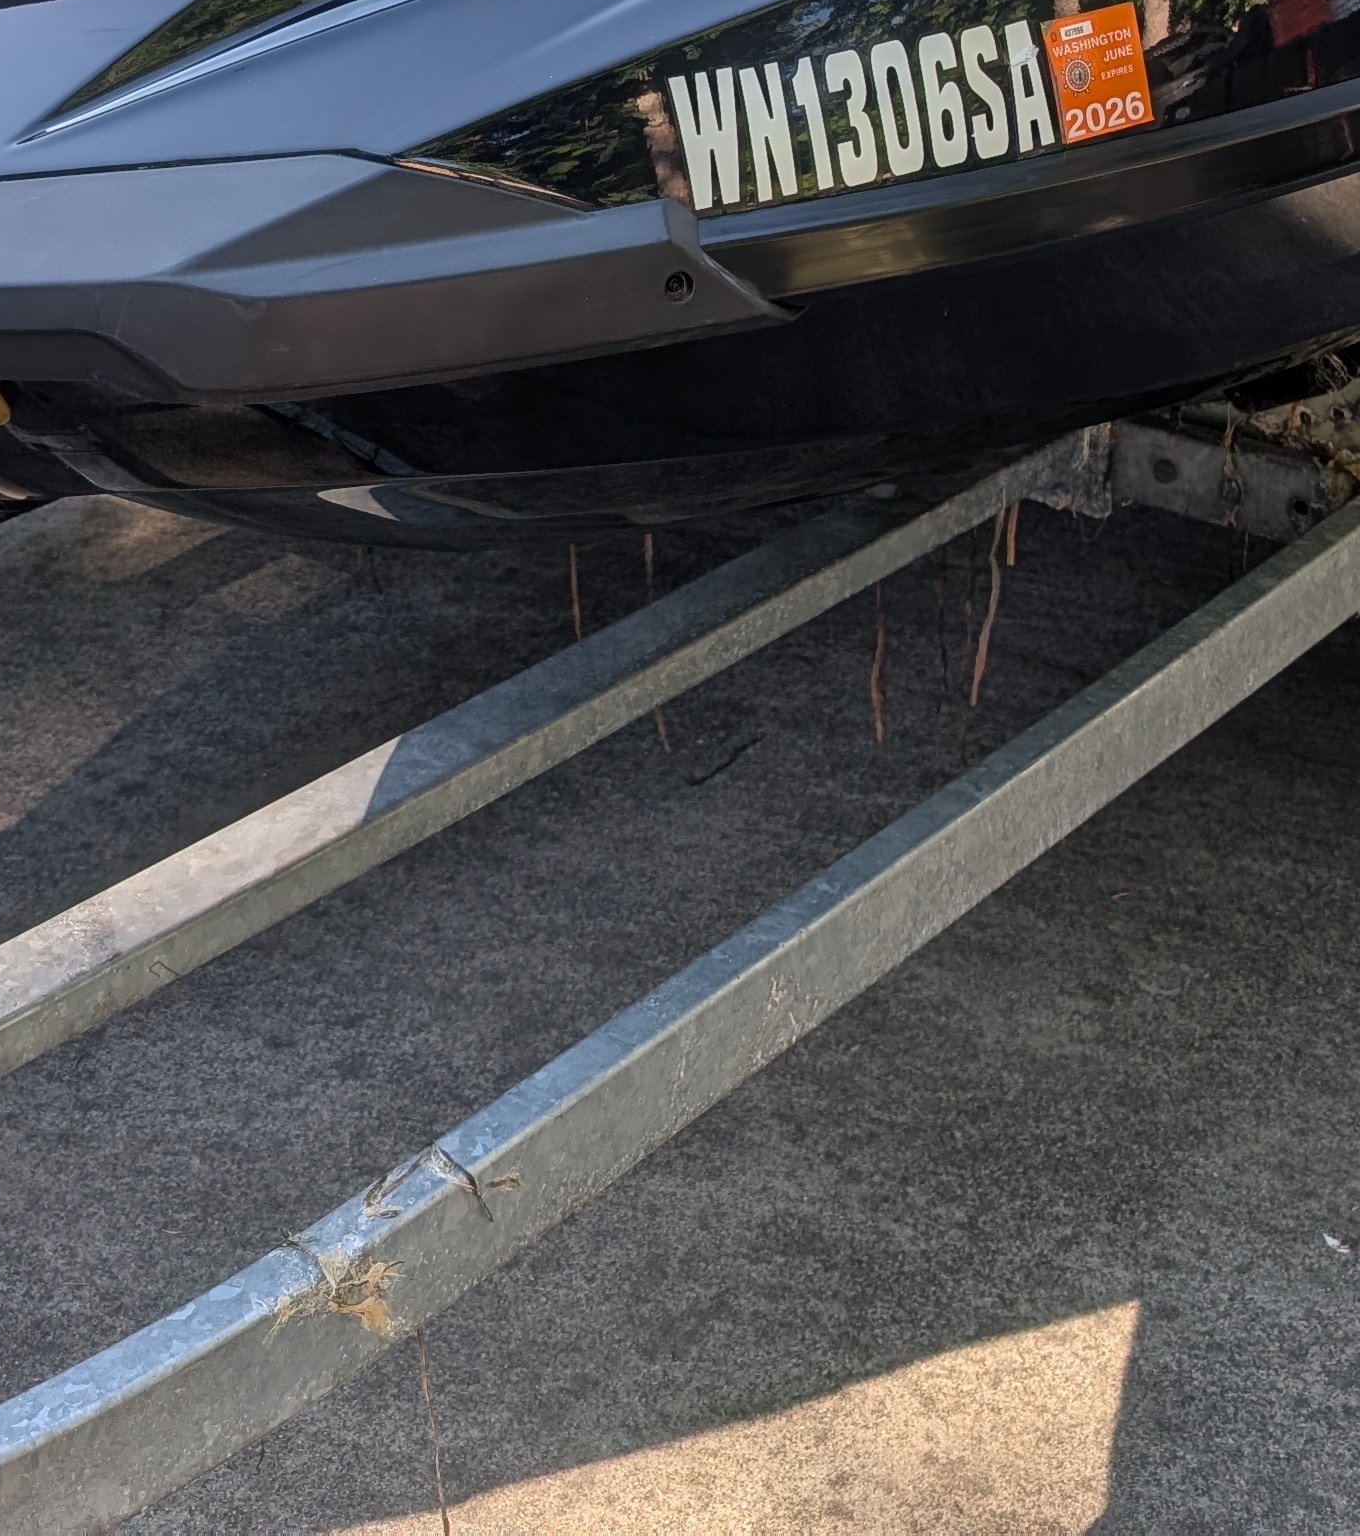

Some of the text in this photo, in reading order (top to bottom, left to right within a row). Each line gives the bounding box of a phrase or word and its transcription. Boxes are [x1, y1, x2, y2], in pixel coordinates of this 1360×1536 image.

[1052, 26, 1132, 57] WASHINGTON
[1103, 44, 1133, 62] JUNE
[1100, 64, 1134, 80] EXPIRES
[668, 20, 1056, 210] WN1306SA
[1065, 91, 1145, 139] 2026
